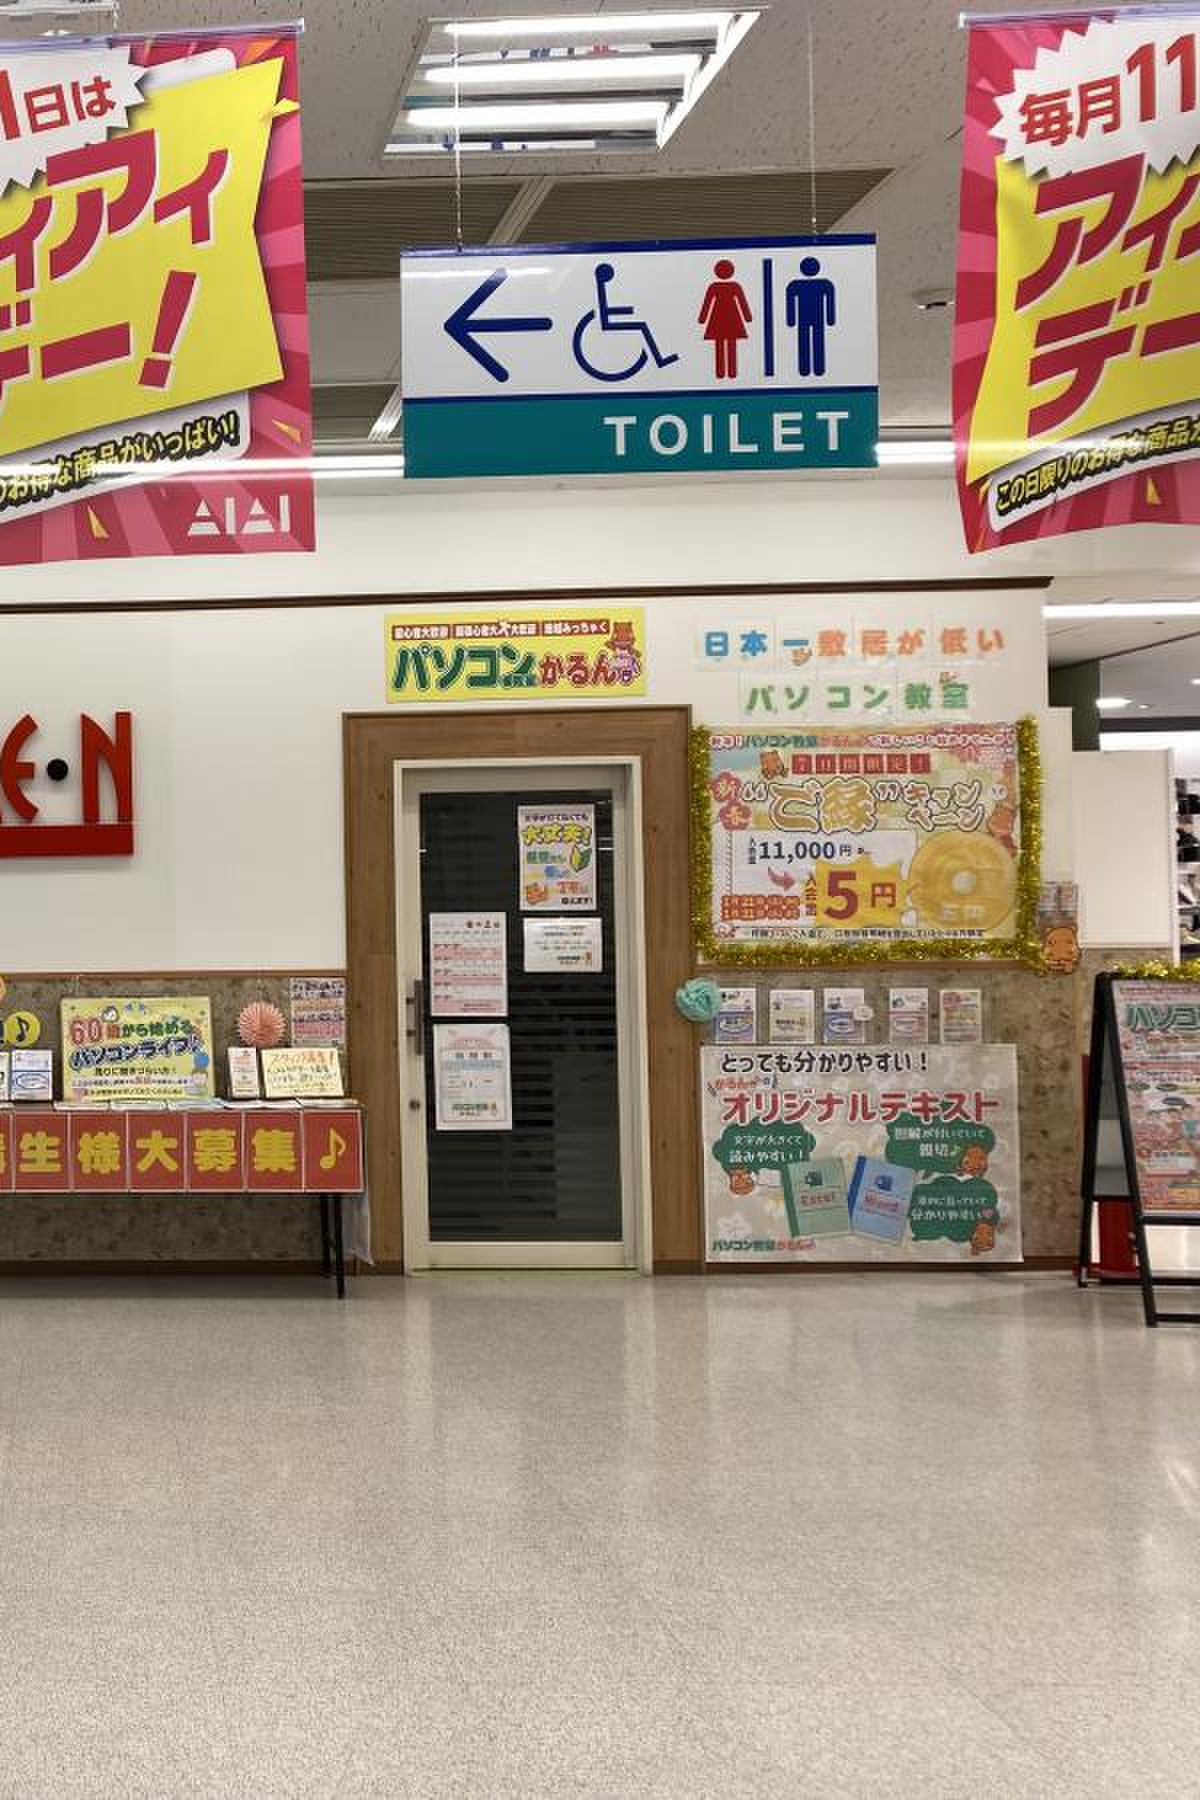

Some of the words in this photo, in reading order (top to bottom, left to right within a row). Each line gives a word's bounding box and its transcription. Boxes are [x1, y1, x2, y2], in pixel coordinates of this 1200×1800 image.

[603, 410, 851, 457] TOILET
[187, 494, 290, 538] AIAI
[704, 629, 1005, 657] 日本一敷居が低い
[745, 682, 969, 711] パソコン教室
[721, 1052, 927, 1073] とっても分かりやすい!
[722, 1089, 999, 1122] オリジナルテキスト
